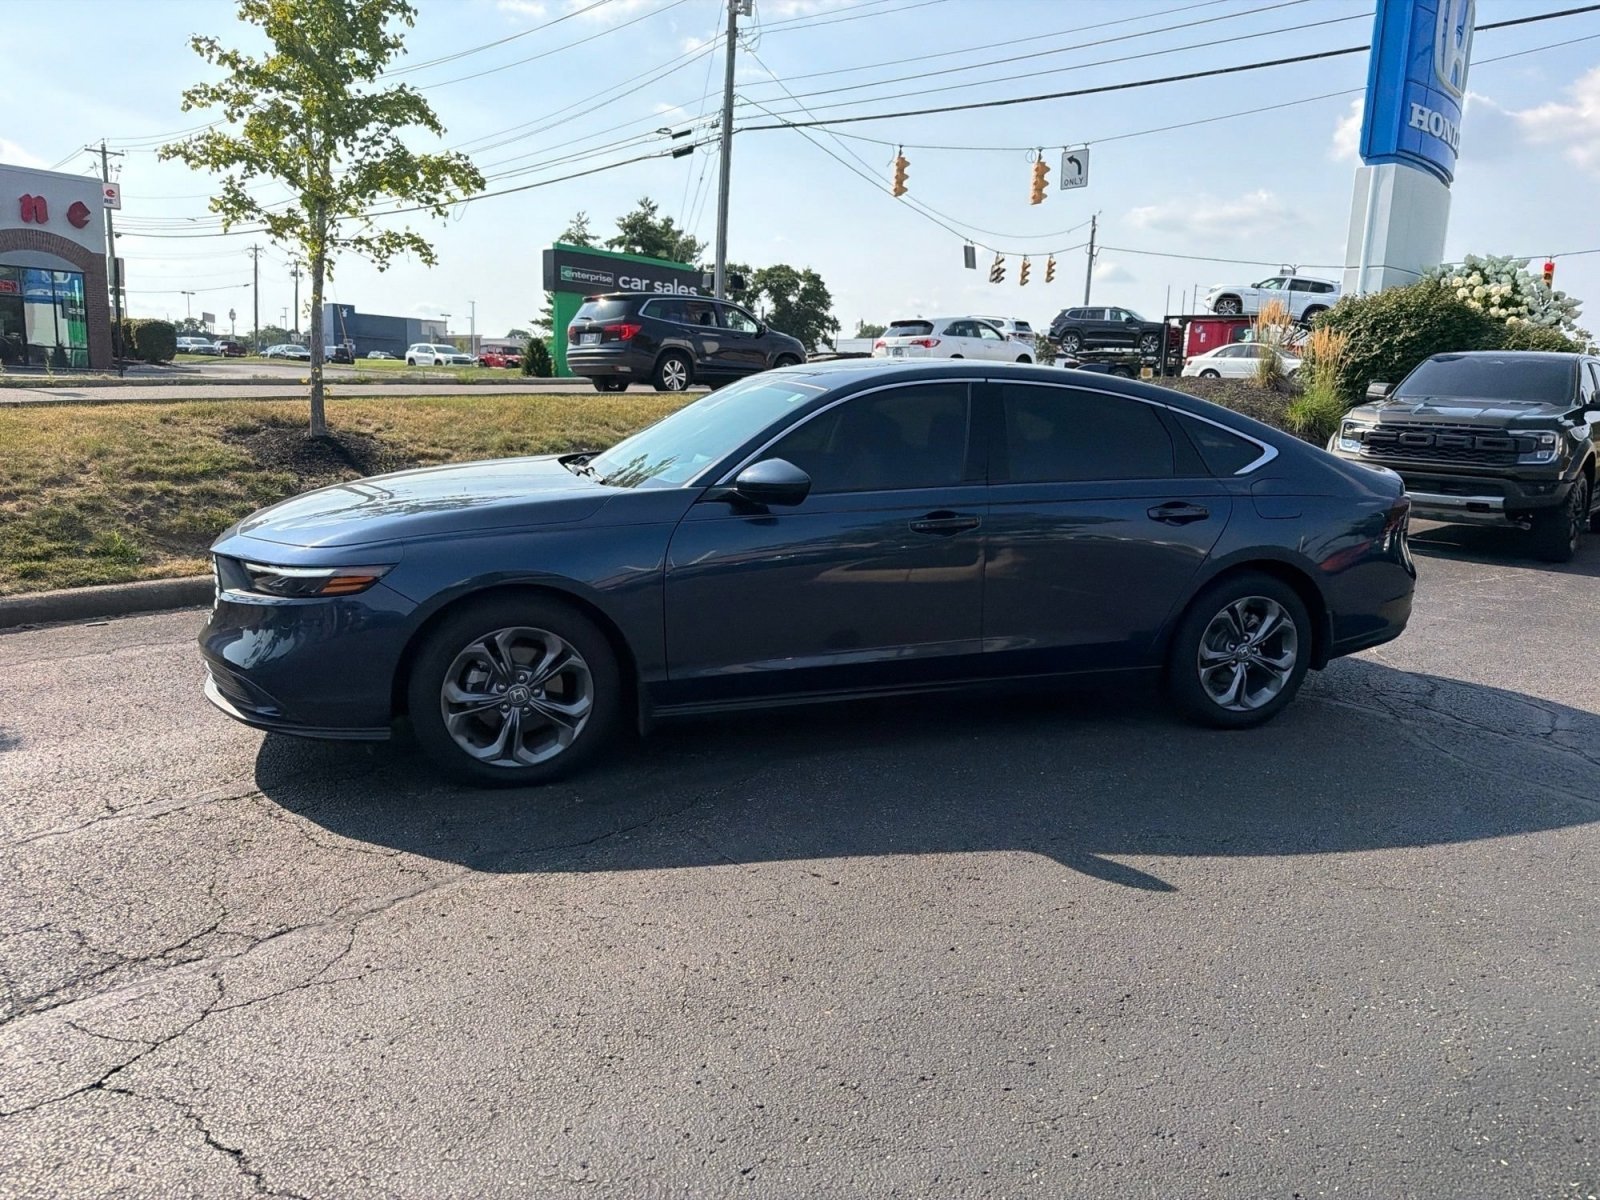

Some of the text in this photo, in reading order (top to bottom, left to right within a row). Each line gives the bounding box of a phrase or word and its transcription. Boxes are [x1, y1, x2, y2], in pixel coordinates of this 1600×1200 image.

[1064, 177, 1084, 187] ONLY
[560, 269, 698, 296] enterprise car sales
[1364, 431, 1517, 451] FORD
